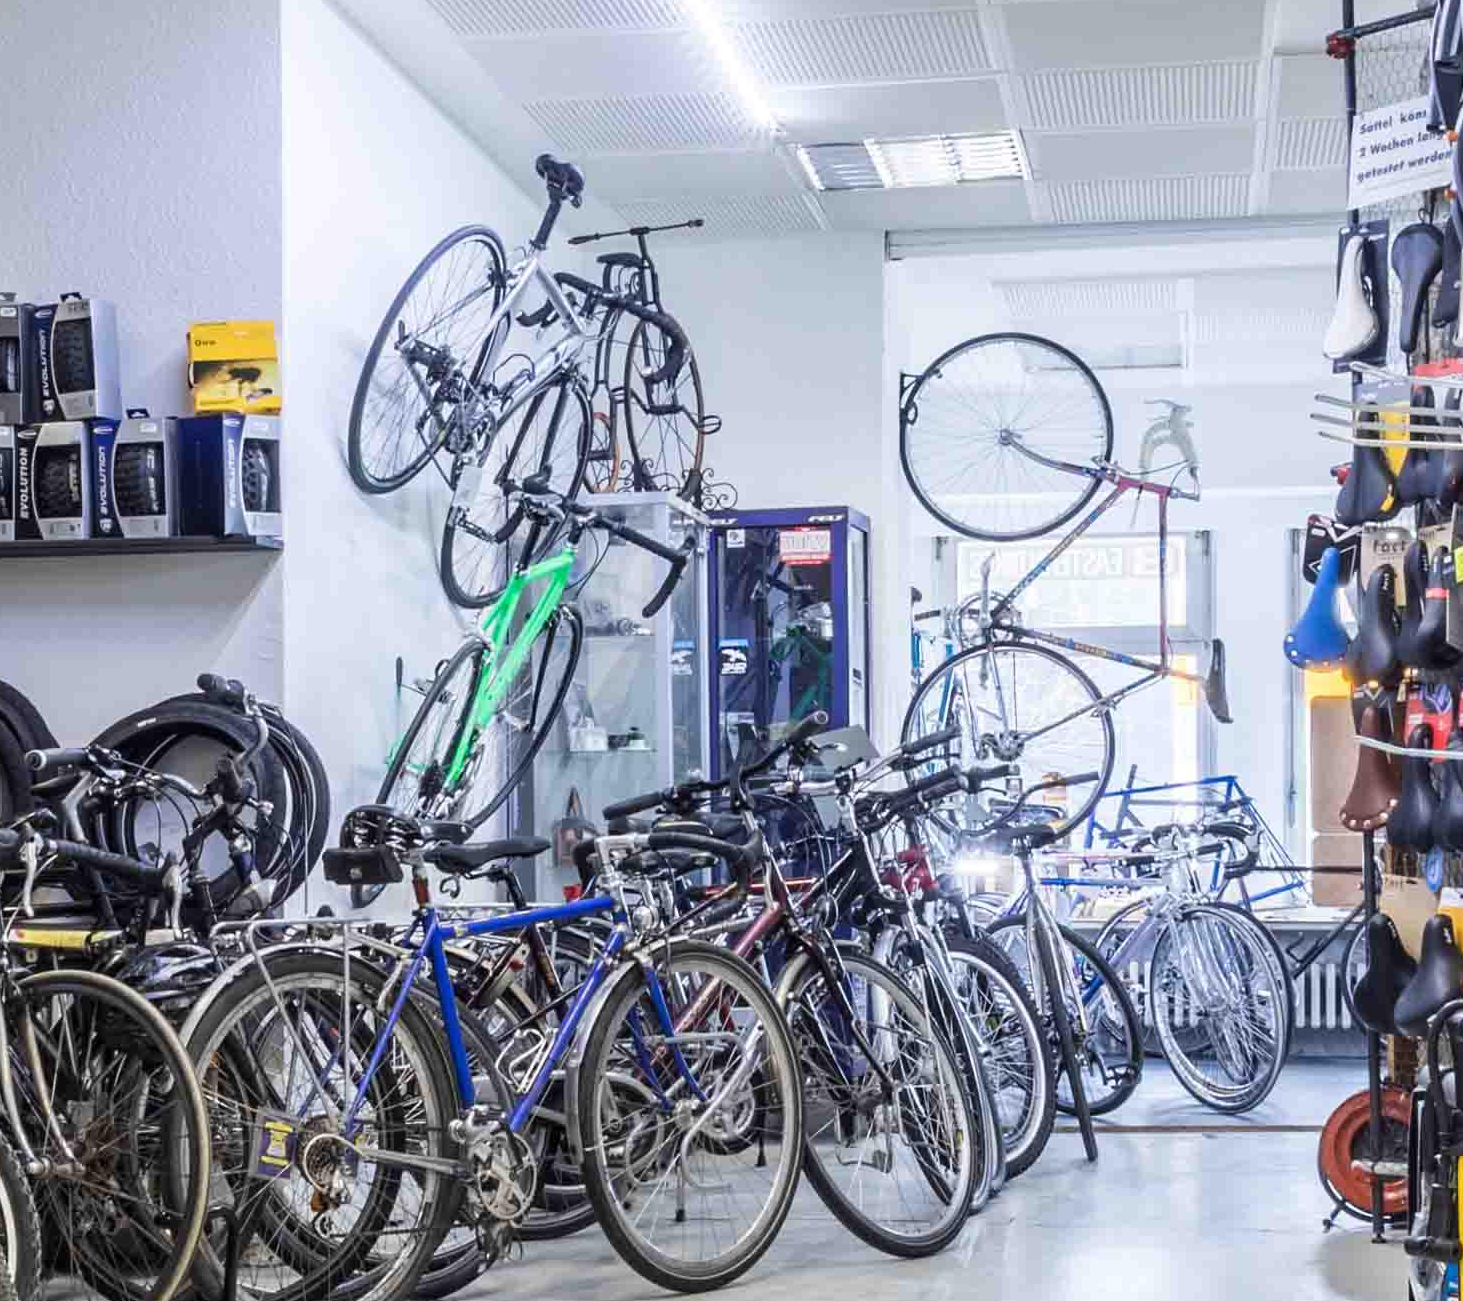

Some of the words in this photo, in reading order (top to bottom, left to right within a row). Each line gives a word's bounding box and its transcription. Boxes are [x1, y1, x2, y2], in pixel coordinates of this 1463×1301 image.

[1359, 116, 1393, 135] Sattel
[1370, 136, 1414, 155] Wochen
[1357, 161, 1405, 184] getestet
[38, 330, 50, 397] EVOLUTION
[20, 447, 29, 519] EVOLUTION
[96, 445, 108, 515] EVOLUTION
